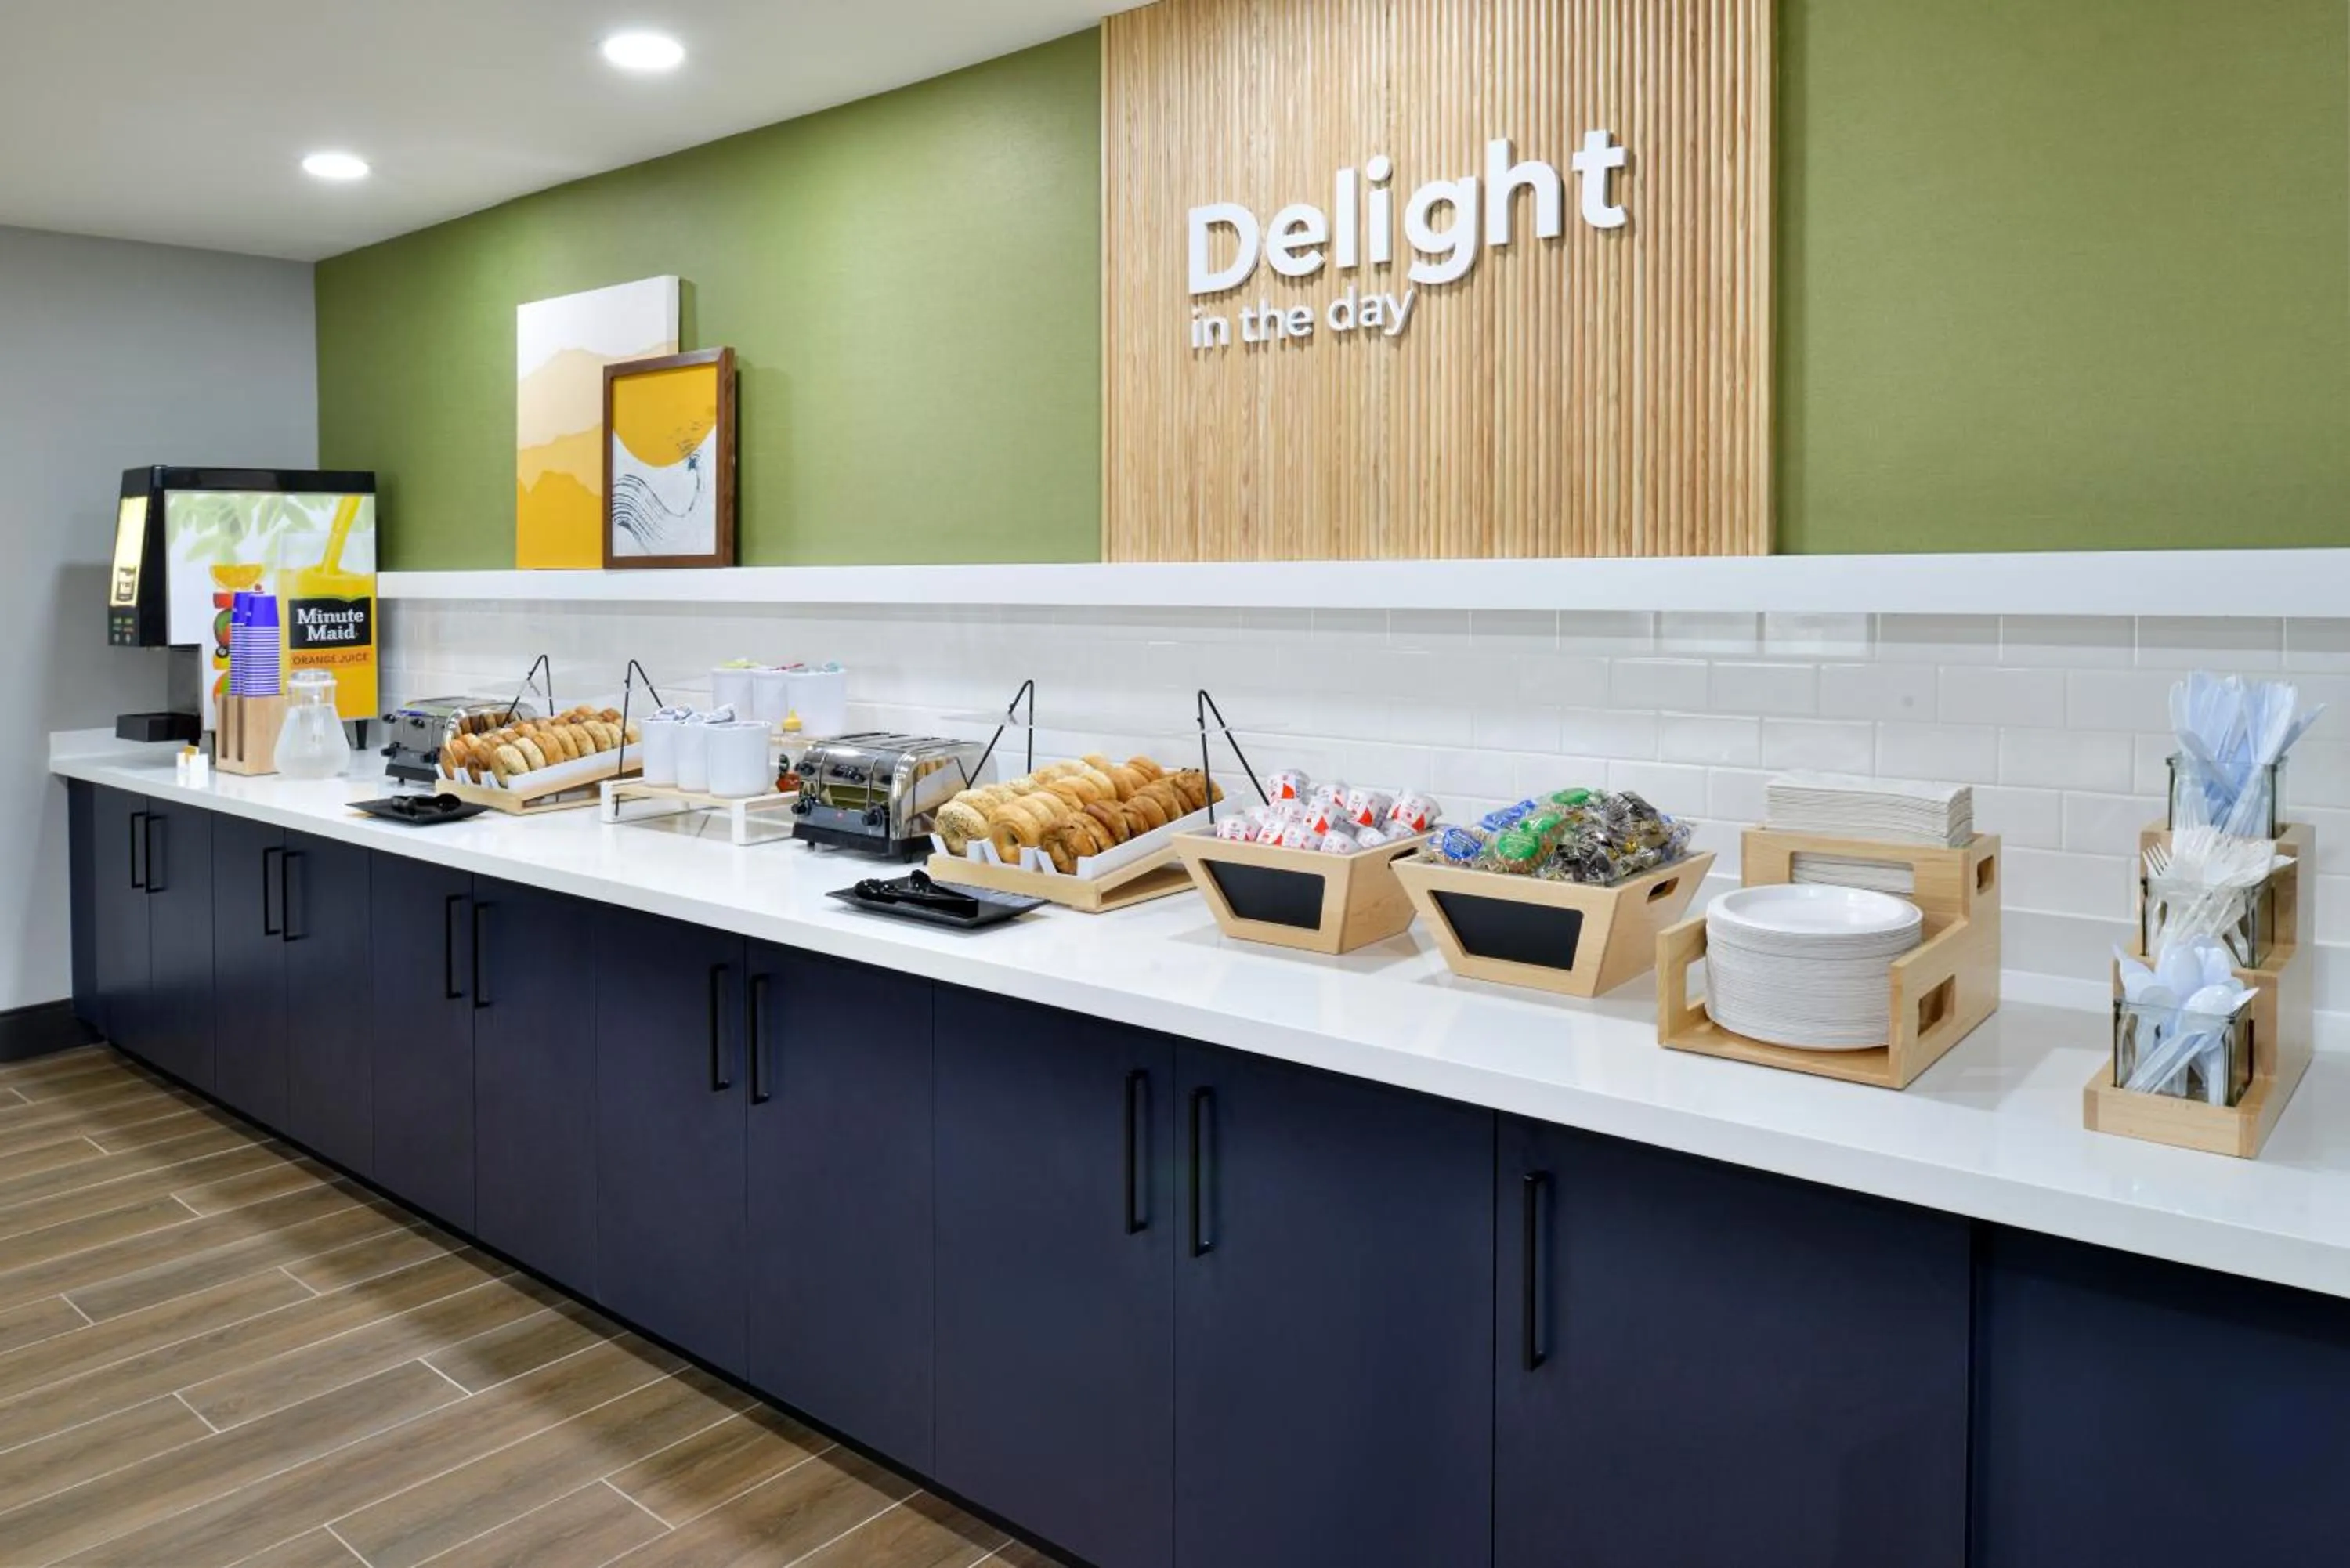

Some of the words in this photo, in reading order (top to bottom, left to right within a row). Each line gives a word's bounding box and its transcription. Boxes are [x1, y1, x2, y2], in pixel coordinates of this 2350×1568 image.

[1188, 128, 1626, 295] Delight
[1191, 305, 1230, 348] in
[1238, 298, 1314, 342] the
[1326, 285, 1416, 336] day
[296, 607, 364, 624] Minute
[306, 623, 356, 641] Maid
[292, 653, 337, 665] ORANGE
[340, 652, 367, 663] JUICE
